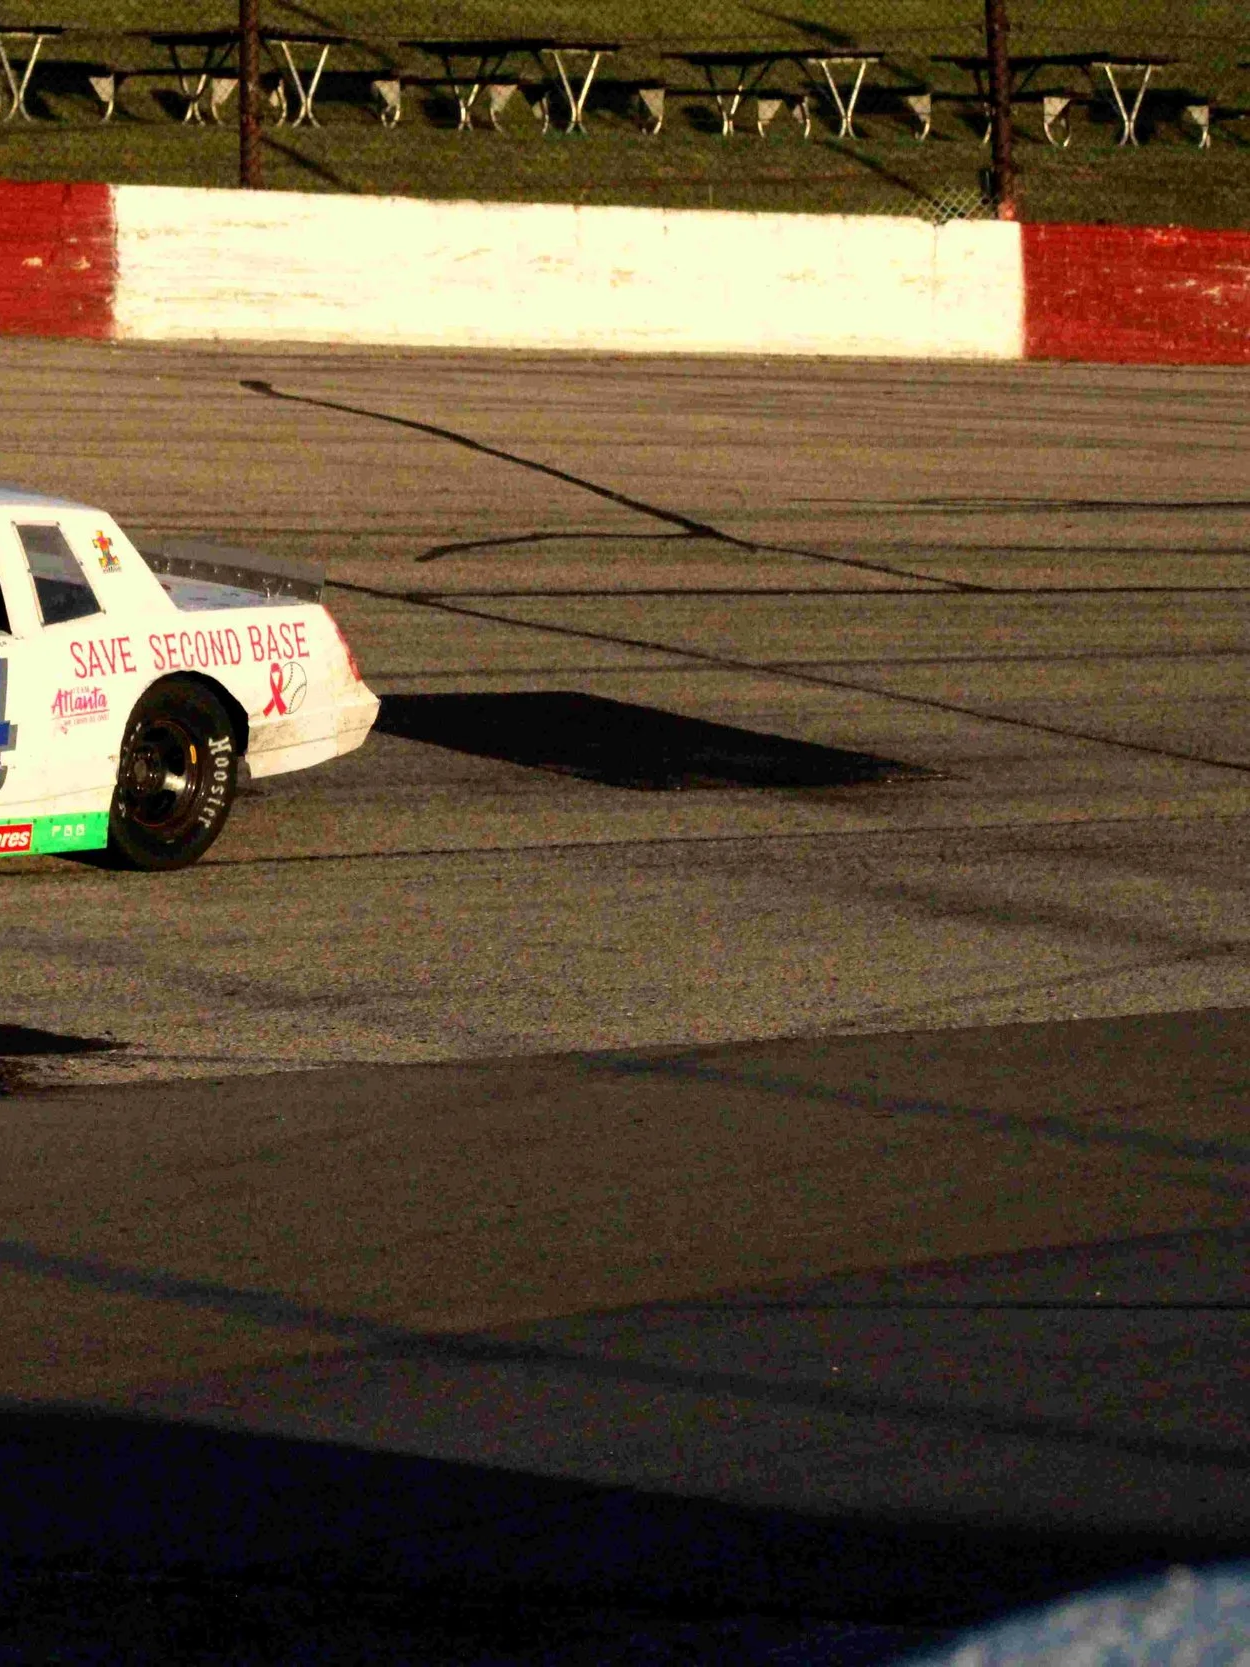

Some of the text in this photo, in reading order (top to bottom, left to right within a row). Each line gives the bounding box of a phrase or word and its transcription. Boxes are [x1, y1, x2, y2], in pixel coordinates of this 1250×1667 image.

[69, 622, 310, 679] SAVE SECOND BASE
[198, 735, 233, 829] Hoosier
